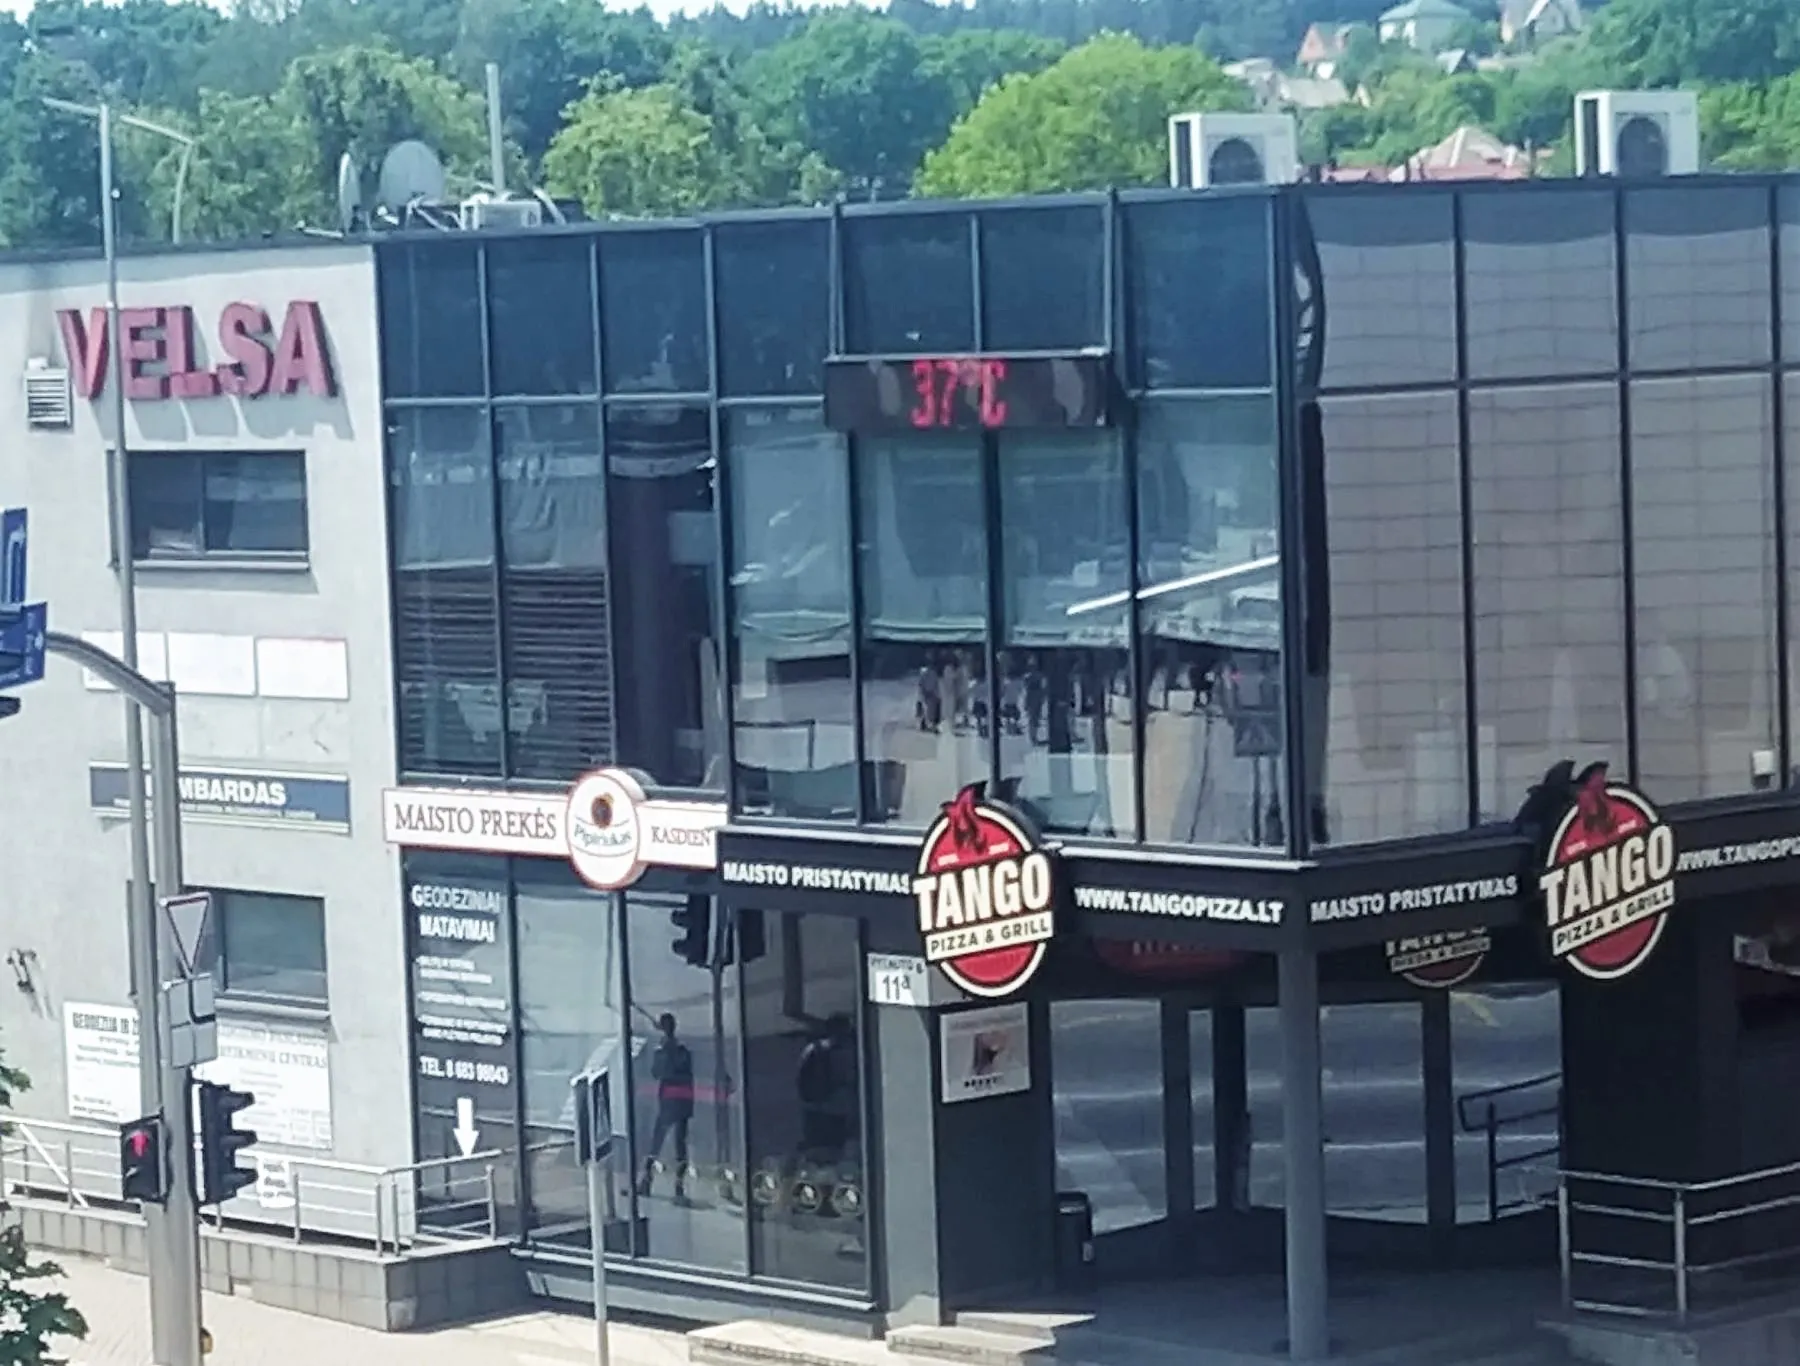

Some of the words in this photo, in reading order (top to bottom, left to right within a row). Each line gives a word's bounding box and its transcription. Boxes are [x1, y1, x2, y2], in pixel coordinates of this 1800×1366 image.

[56, 300, 338, 400] VELSA
[145, 774, 287, 806] MBARDAS
[394, 803, 475, 834] MAISTO
[480, 807, 557, 839] PREKĖS
[723, 861, 788, 885] MAISTO
[791, 866, 911, 894] PRISTATYMAS
[913, 853, 1050, 932] TANGO
[1540, 825, 1674, 926] TANGO
[1074, 887, 1284, 924] WWW.TANGOPIZZA.LT
[1310, 893, 1385, 923] MAISTO
[1389, 875, 1518, 912] PRISTATYMAS
[1556, 914, 1605, 949] PIZZA
[1611, 906, 1620, 924] &
[1626, 886, 1671, 917] GRILL
[419, 914, 496, 944] MATAVIMAI
[931, 932, 979, 954] PIZZA
[985, 929, 995, 945] &
[1001, 918, 1048, 940] GRILL
